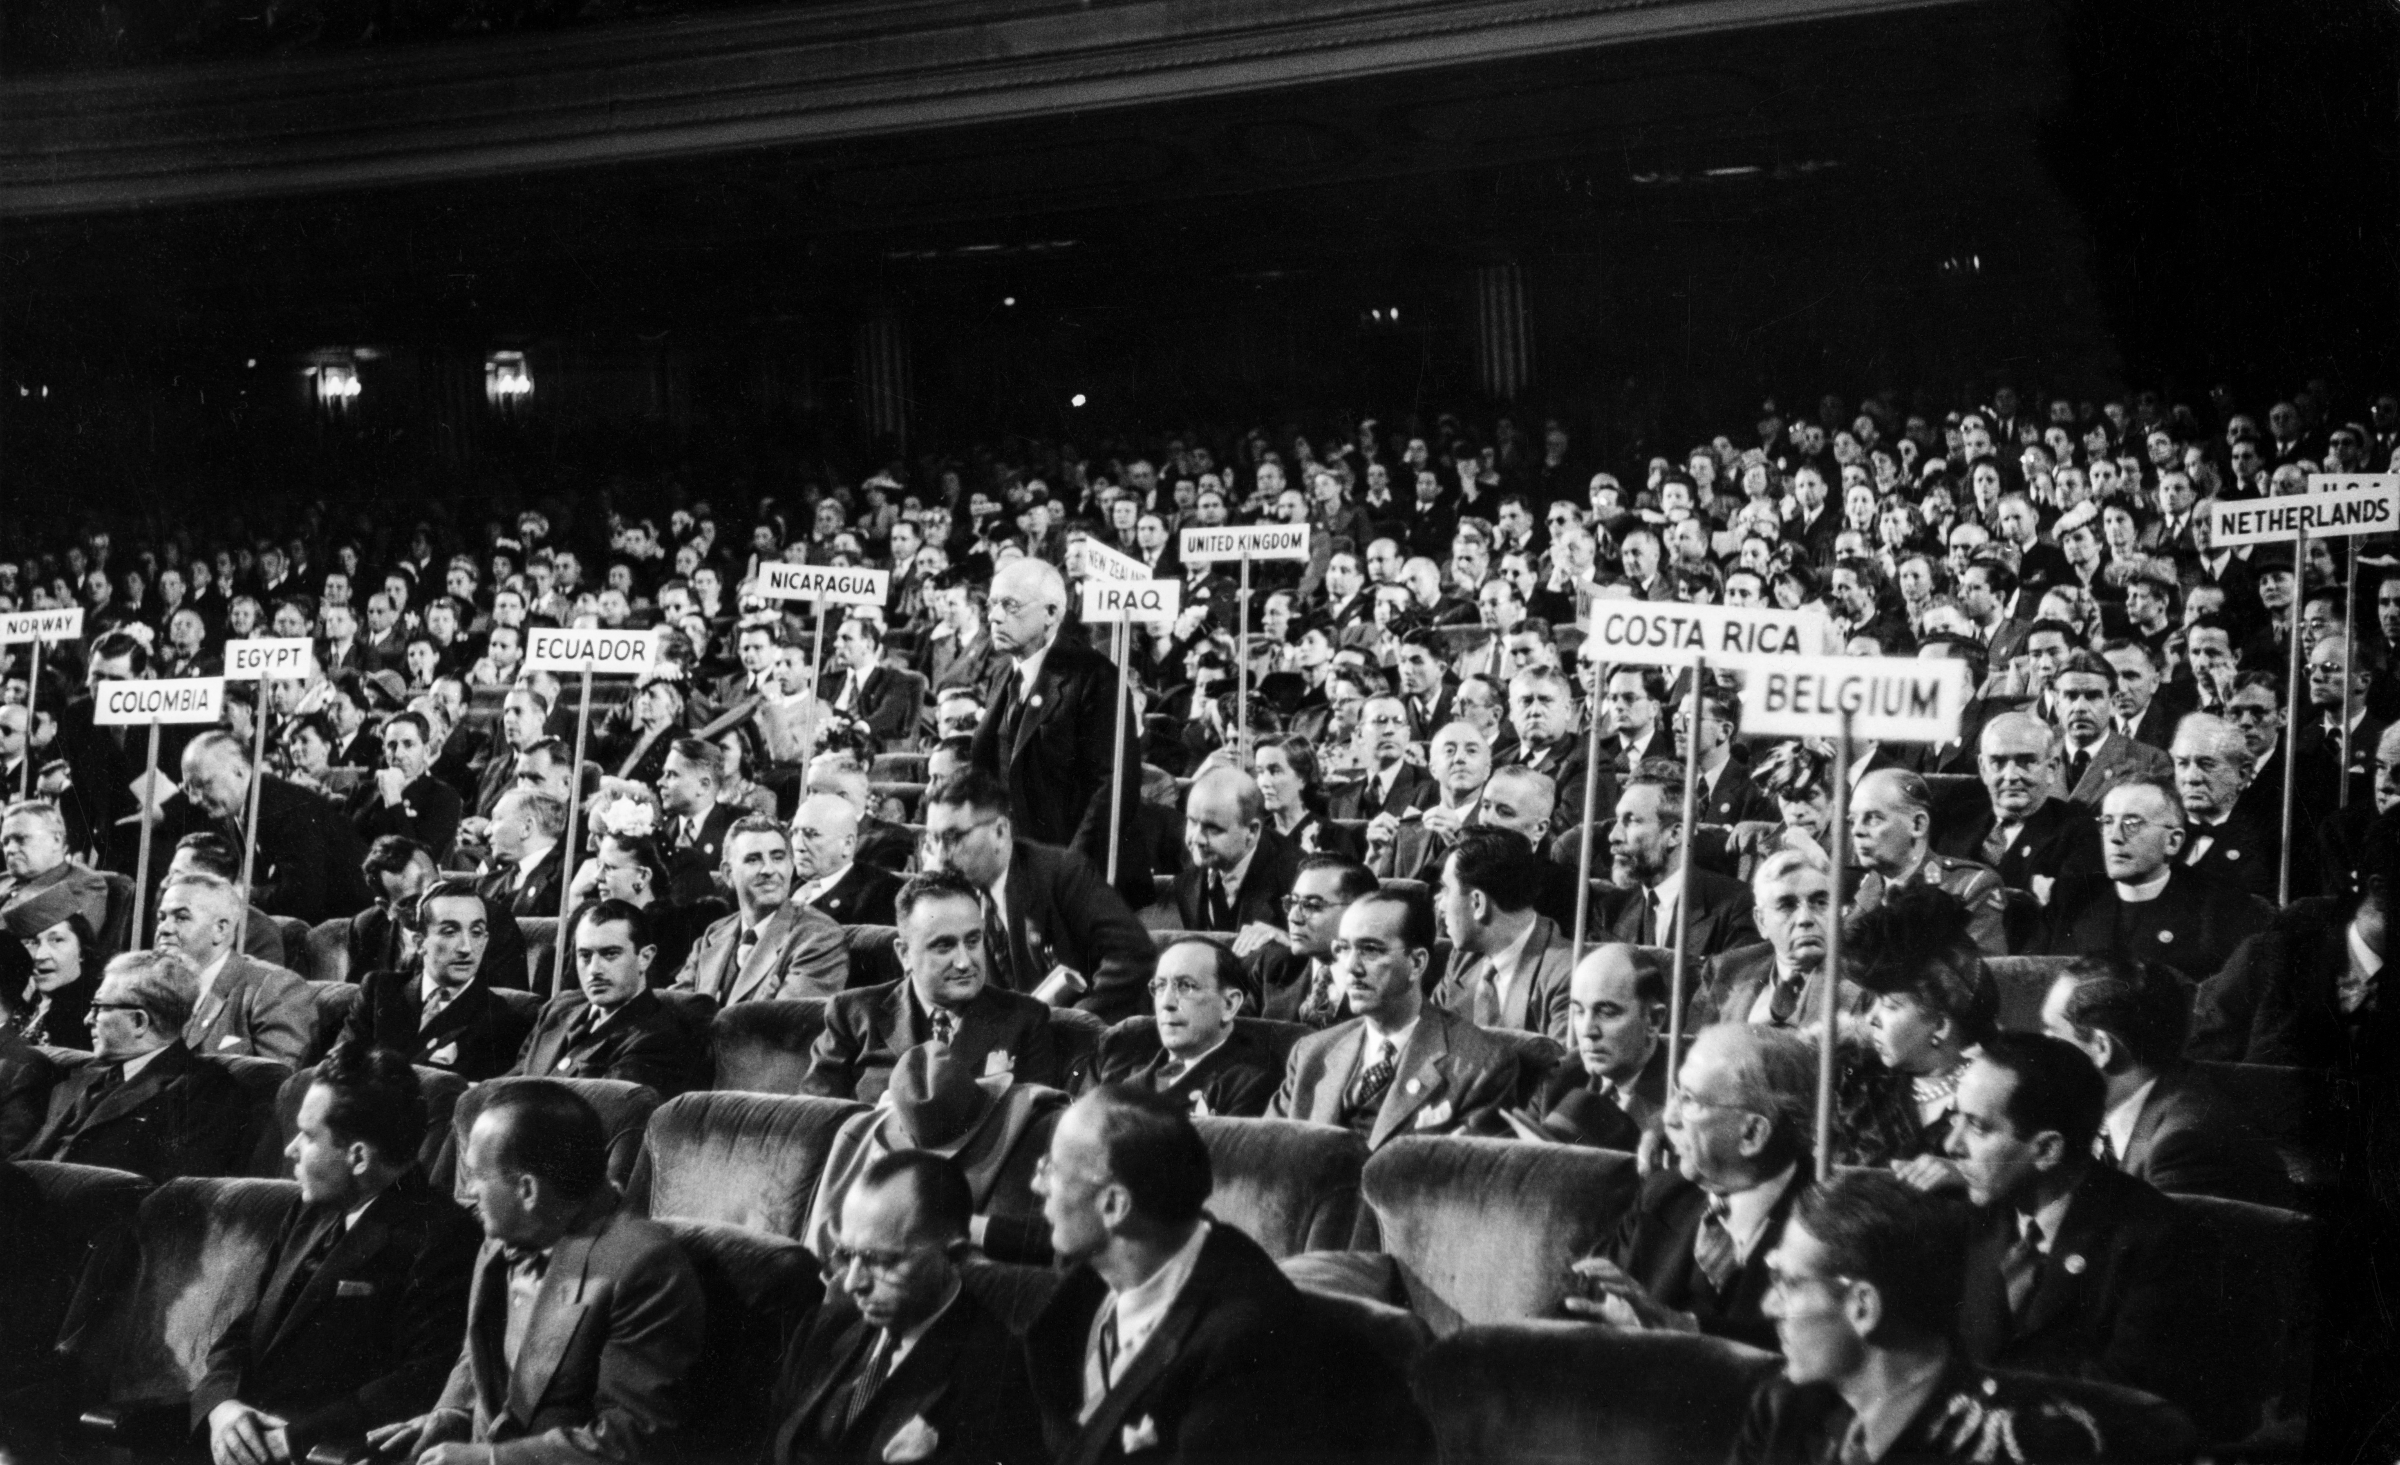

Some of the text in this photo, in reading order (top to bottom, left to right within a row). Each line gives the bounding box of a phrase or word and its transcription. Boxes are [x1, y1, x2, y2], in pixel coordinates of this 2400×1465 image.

[2222, 498, 2390, 535] NETHERLANDS
[1188, 532, 1302, 553] UNITED KINGDOM
[1088, 549, 1106, 572] NEW
[770, 571, 876, 595] NICARAGUA
[1098, 589, 1162, 611] IRAQ
[6, 615, 73, 634] NORWAY
[1604, 613, 1800, 654] COSTA RICA
[237, 647, 303, 669] EGYPT
[536, 637, 646, 661] ECUADOR
[109, 688, 209, 714] COLOMBIA
[1765, 673, 1940, 719] BELGIUM
